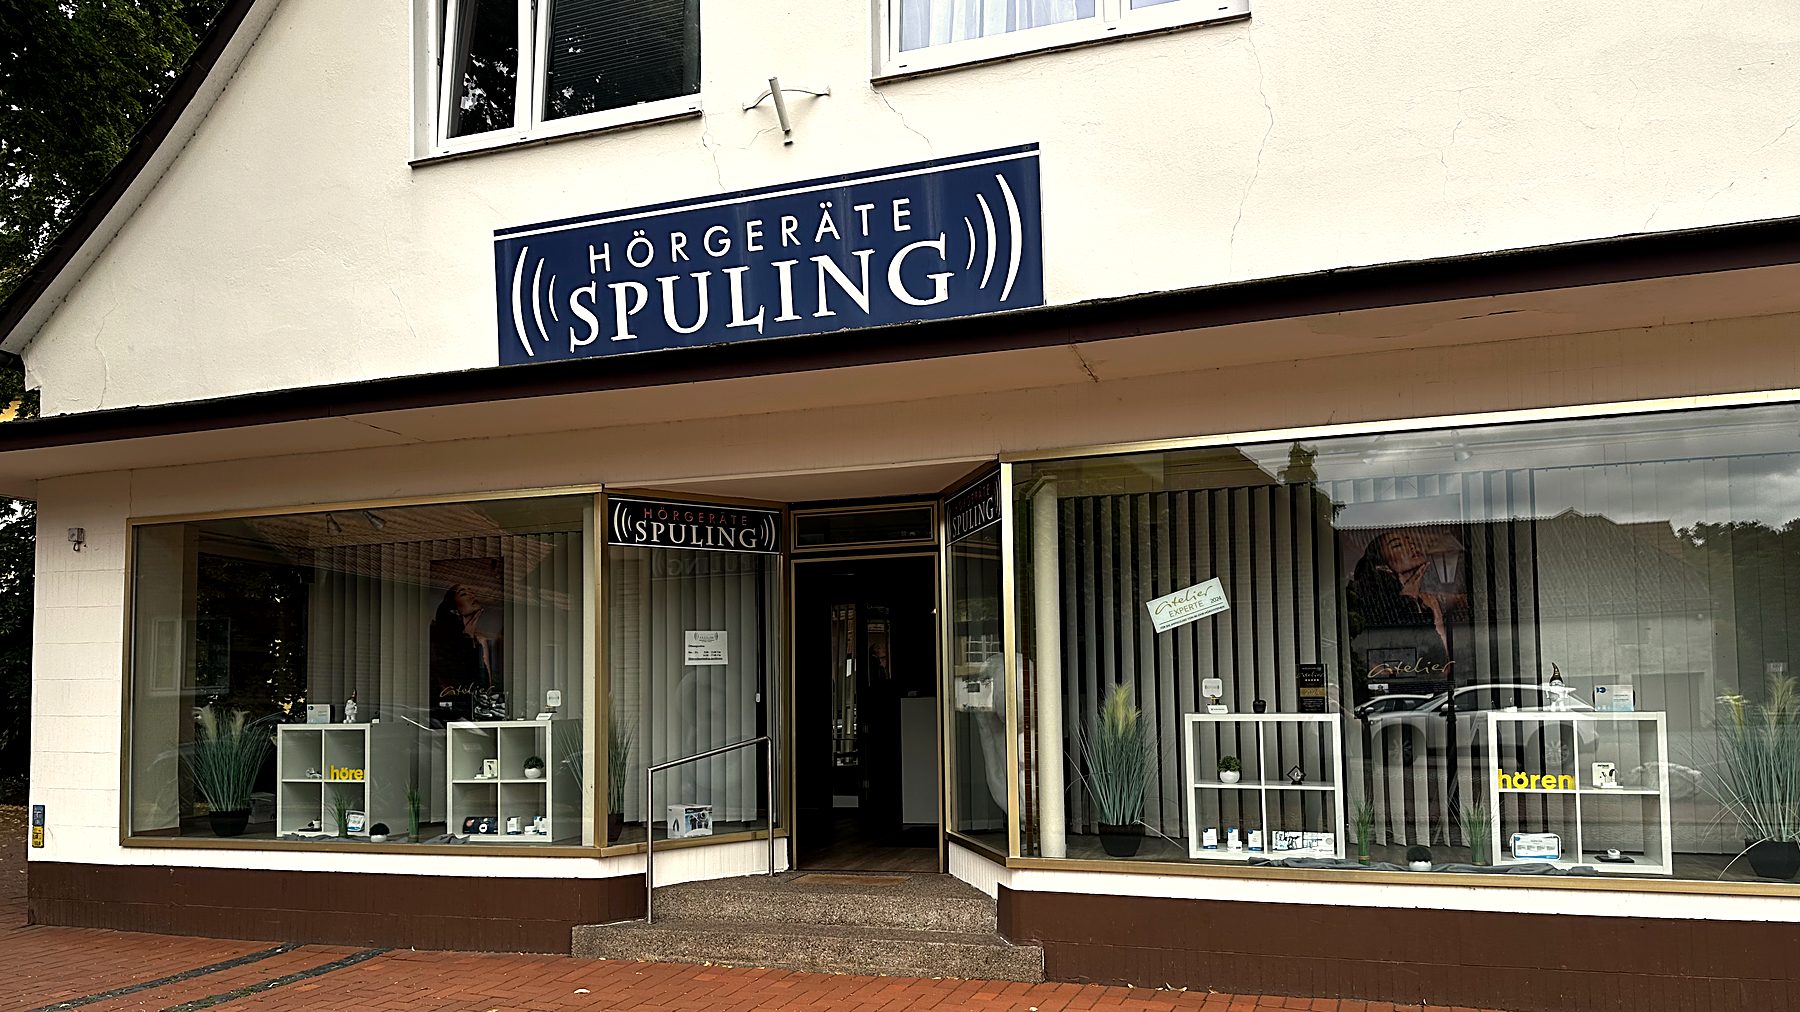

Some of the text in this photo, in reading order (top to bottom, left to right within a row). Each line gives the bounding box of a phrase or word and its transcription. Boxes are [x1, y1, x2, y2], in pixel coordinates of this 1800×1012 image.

[588, 198, 913, 275] HÖRGERÄTE
[568, 231, 955, 354] SPULING
[643, 506, 748, 526] HÖRGERÄTE
[952, 497, 994, 539] SPULING
[635, 520, 758, 549] SPULING
[1169, 600, 1205, 618] EXPERTE
[1210, 595, 1222, 604] 2024
[330, 764, 367, 780] höre
[1498, 768, 1575, 790] hören
